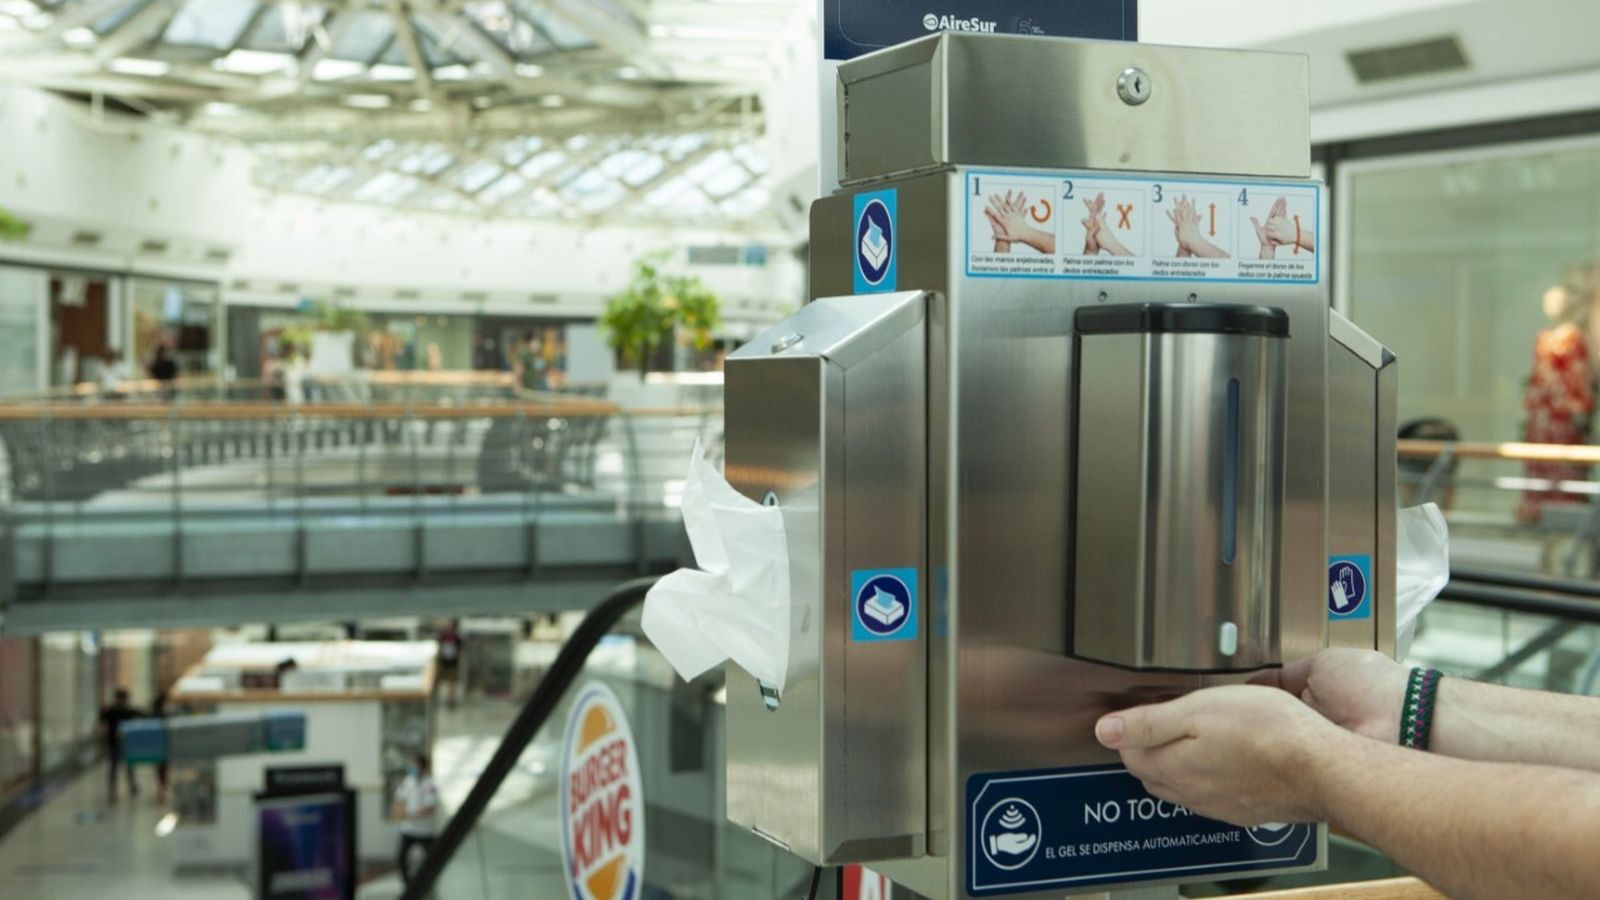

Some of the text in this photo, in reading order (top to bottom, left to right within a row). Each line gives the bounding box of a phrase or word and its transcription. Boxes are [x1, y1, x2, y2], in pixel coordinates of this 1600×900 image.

[938, 14, 997, 33] AireSur
[972, 177, 981, 196] 1
[1063, 180, 1074, 199] 2
[1153, 184, 1163, 203] 3
[1237, 188, 1249, 206] 4
[570, 738, 628, 817] BURGER
[1084, 798, 1193, 825] NO TOCA
[572, 784, 631, 879] KING
[1046, 831, 1240, 859] EL GEL SE DISPENSA AUTOMATICAMENTE
